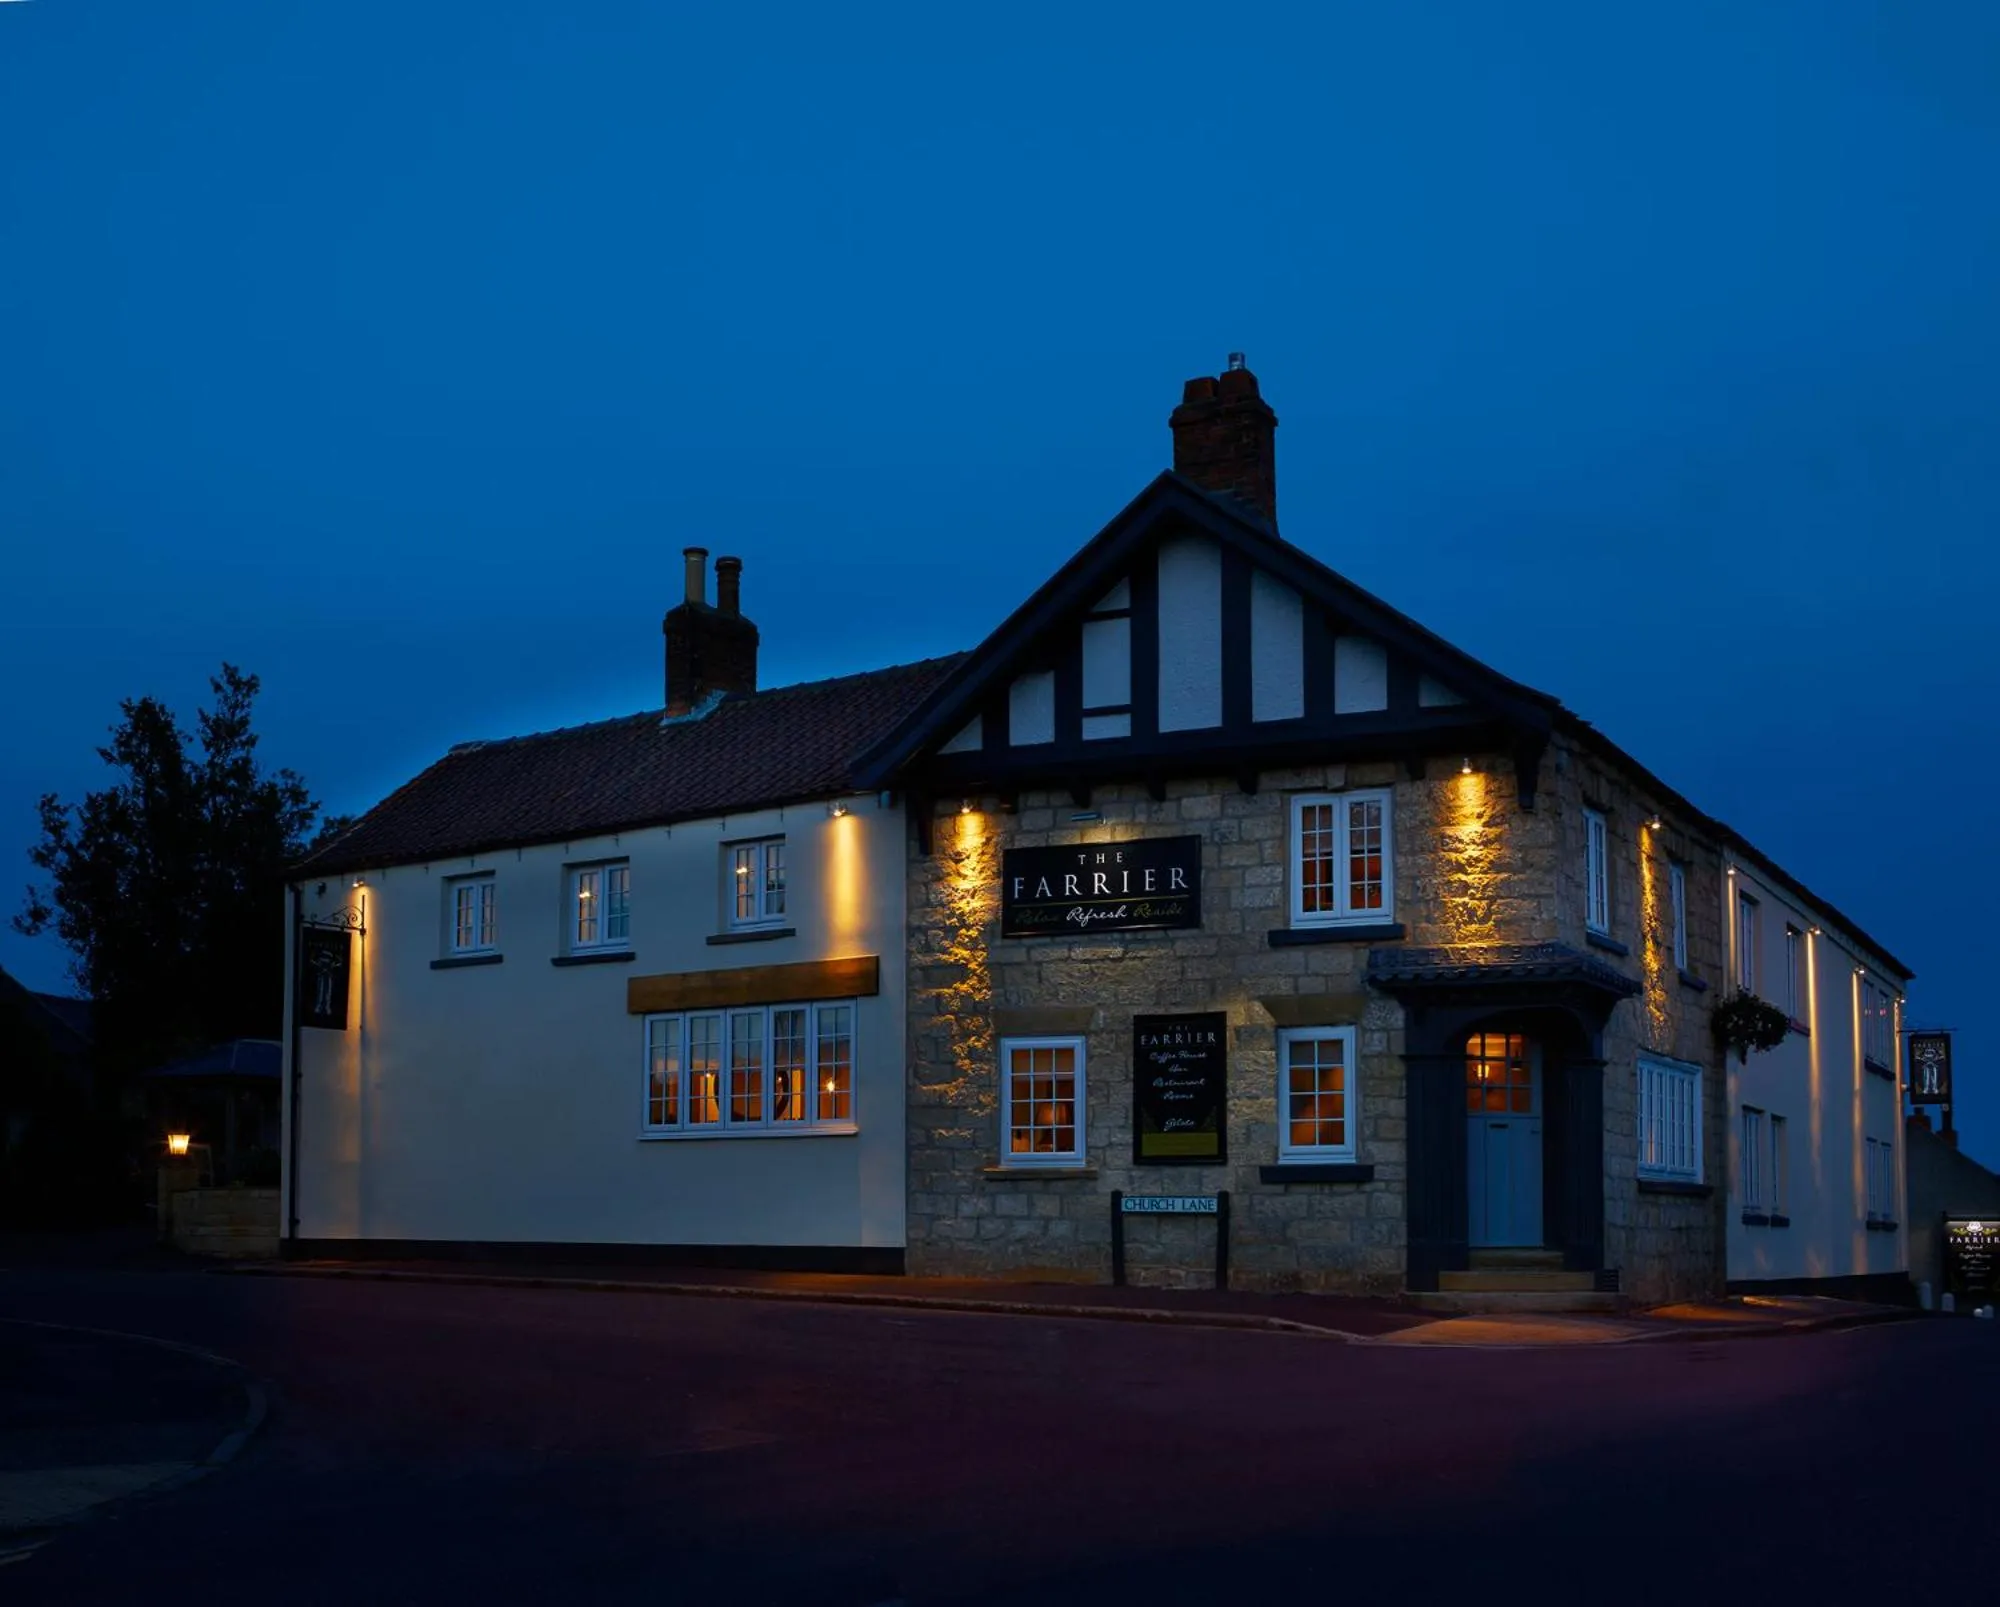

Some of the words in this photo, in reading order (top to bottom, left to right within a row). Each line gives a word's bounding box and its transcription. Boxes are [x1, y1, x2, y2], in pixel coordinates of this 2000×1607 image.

[1077, 851, 1124, 865] THE
[1013, 866, 1189, 900] FARRIER
[1066, 904, 1128, 928] Refresh
[1140, 1031, 1216, 1046] FARRIER
[1125, 1198, 1176, 1211] CHURCH
[1182, 1198, 1216, 1211] LANE
